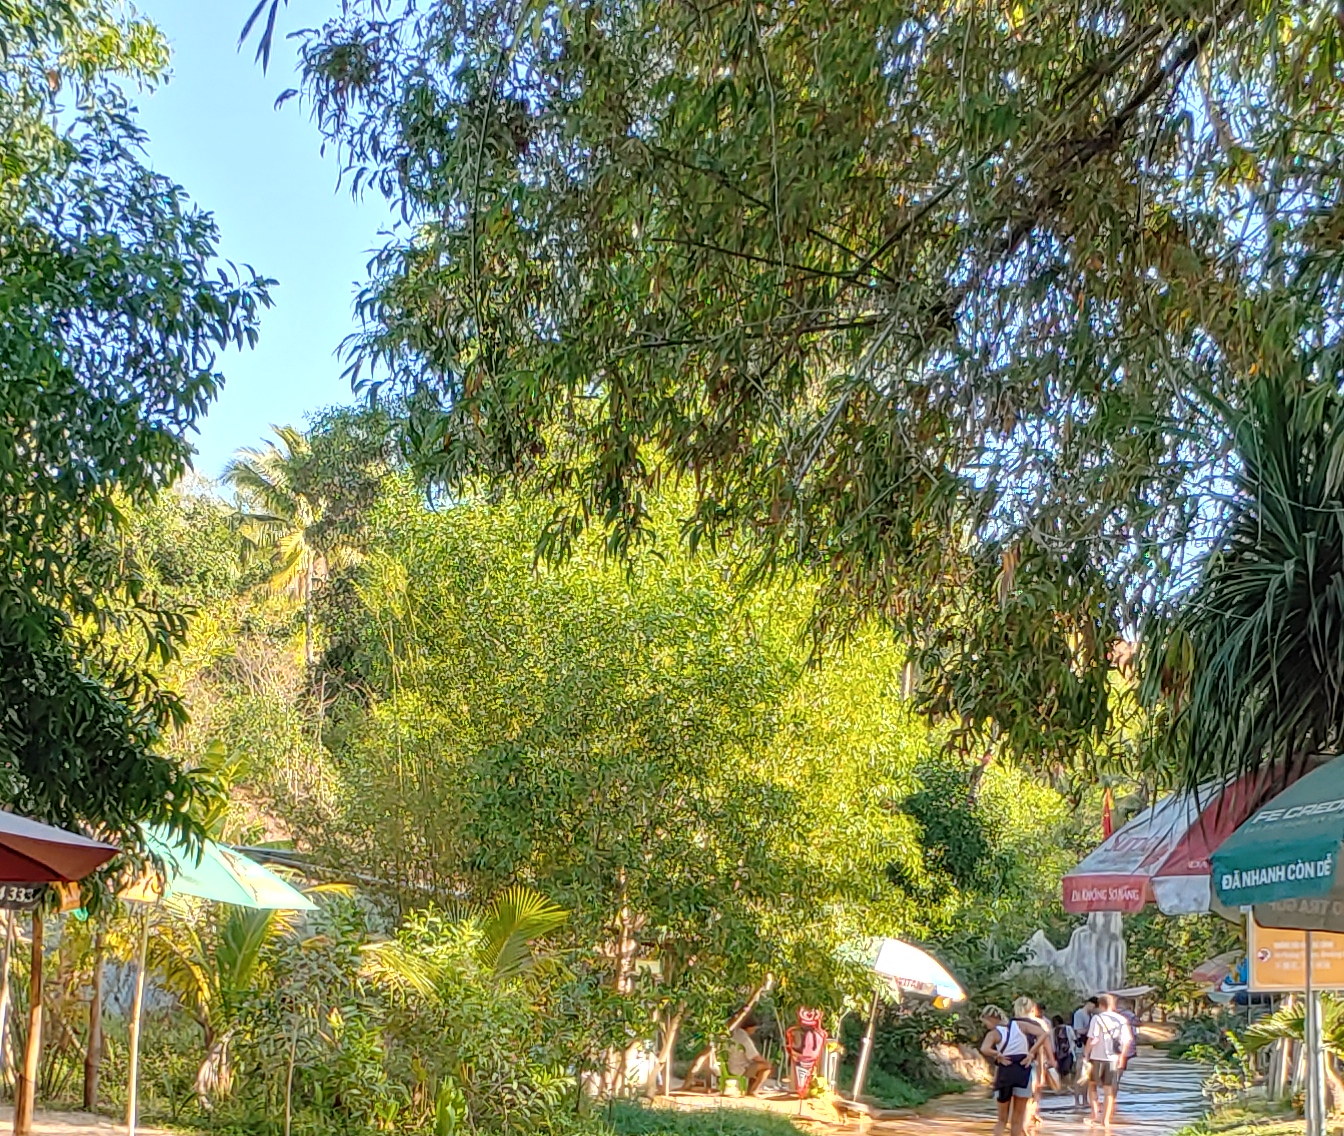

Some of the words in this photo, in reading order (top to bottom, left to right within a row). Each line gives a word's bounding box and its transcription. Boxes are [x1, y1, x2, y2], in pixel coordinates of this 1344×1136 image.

[1252, 808, 1286, 824] FE
[1222, 869, 1242, 891] ĐÃ
[1242, 864, 1286, 888] NHANH
[1287, 859, 1315, 880] CÒN
